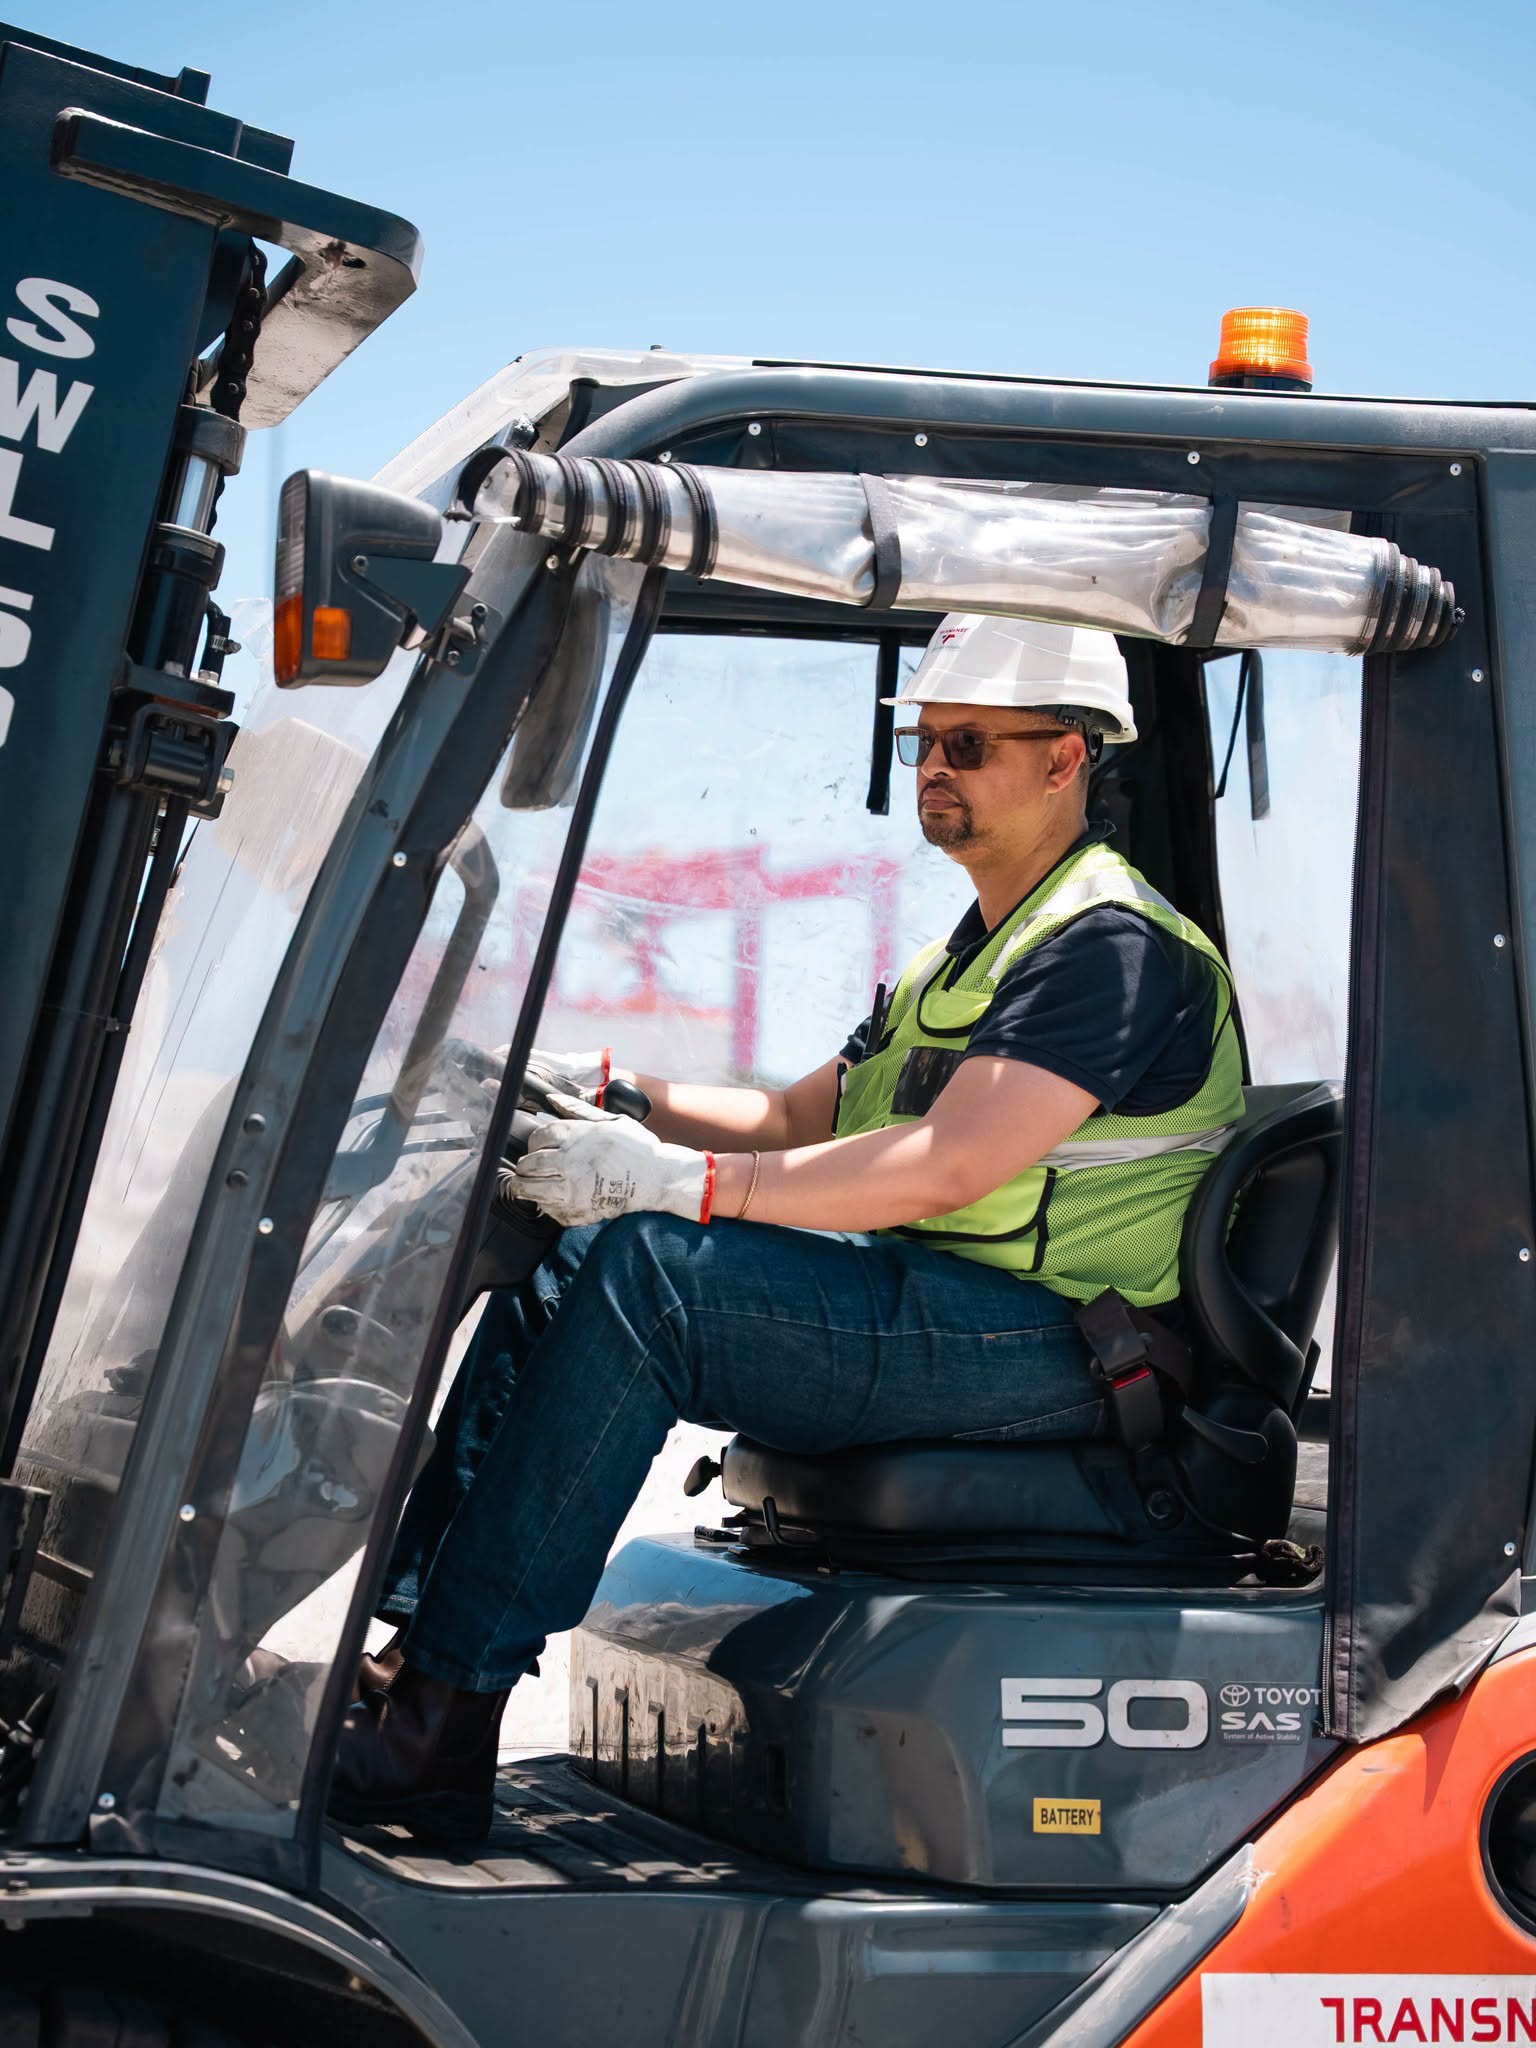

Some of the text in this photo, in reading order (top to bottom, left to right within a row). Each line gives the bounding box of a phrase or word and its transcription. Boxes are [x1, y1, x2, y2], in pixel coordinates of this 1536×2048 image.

[1001, 1678, 1208, 1748] 50
[1221, 1711, 1301, 1731] SAS
[1255, 1732, 1274, 1740] Active
[1041, 1808, 1094, 1826] BATTERY
[1320, 1997, 1536, 2043] TRANSN
